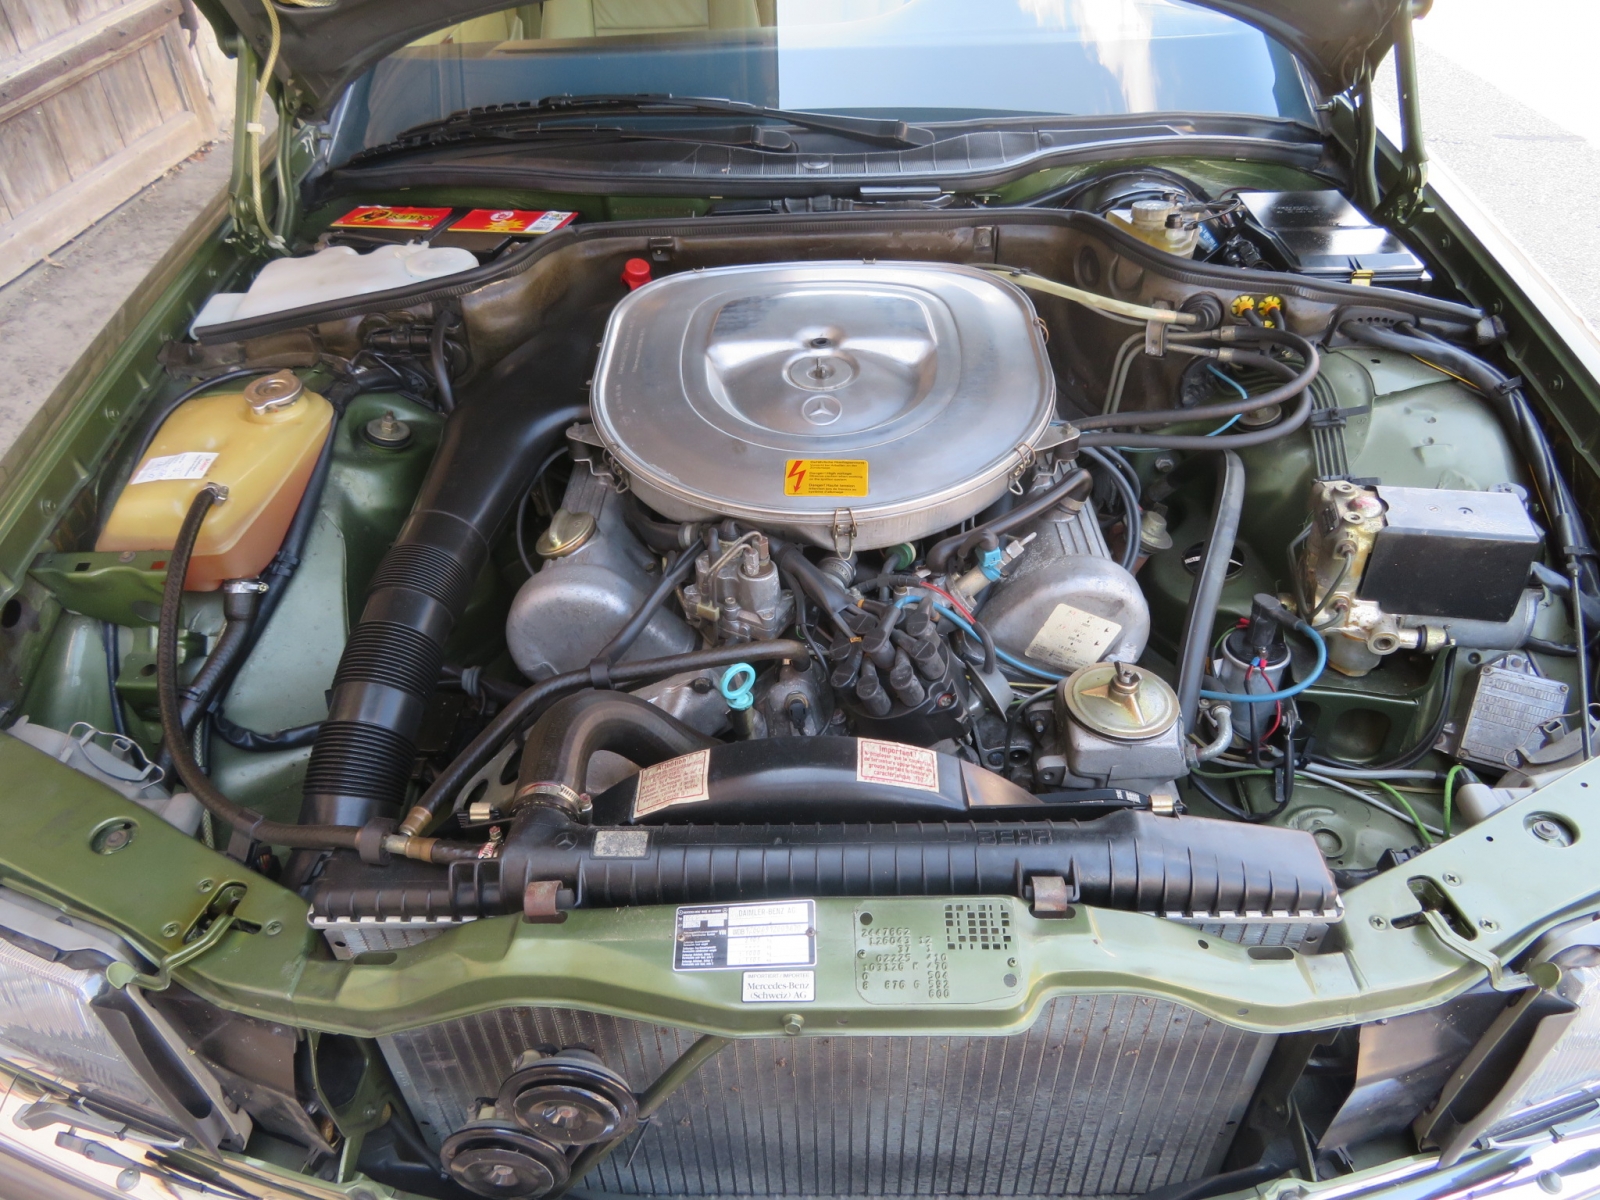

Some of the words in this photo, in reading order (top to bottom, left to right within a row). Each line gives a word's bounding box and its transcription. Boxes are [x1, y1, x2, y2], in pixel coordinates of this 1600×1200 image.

[738, 908, 785, 917] DAIMLER-BENZ
[747, 982, 809, 990] Mercedes-Benz
[750, 991, 791, 1000] (Schweiz)
